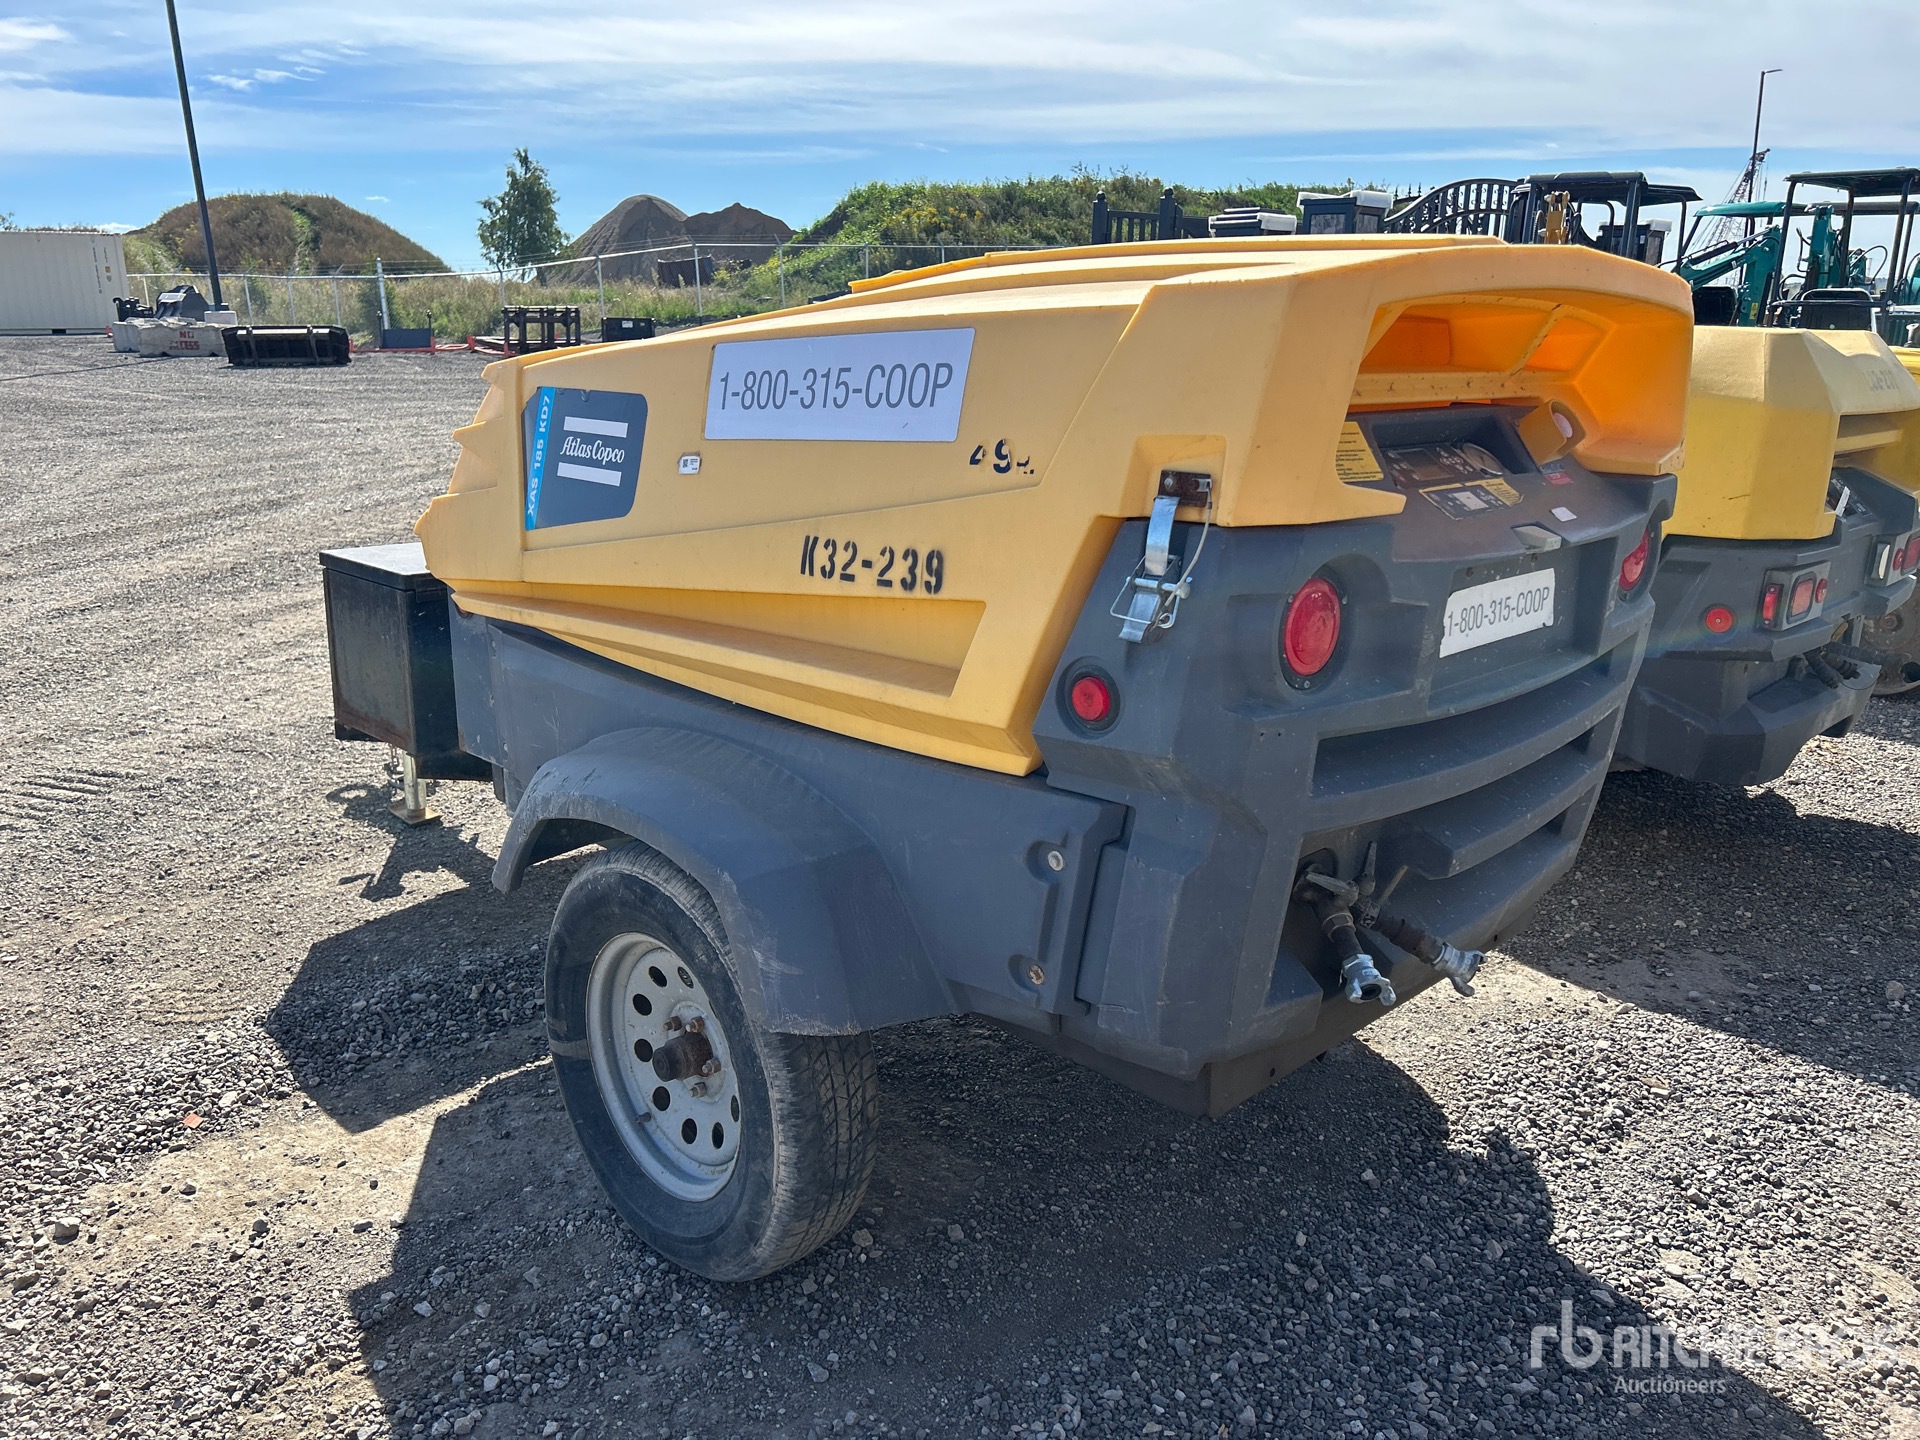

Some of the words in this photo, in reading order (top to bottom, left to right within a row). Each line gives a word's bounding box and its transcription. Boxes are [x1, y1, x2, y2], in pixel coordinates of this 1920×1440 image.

[719, 362, 954, 411] 1-800-315-COOP
[527, 477, 539, 516] XAS
[534, 439, 544, 469] 185
[539, 395, 551, 433] KD7
[800, 535, 945, 595] K32-239
[1447, 586, 1550, 637] 1-800-315-COOP
